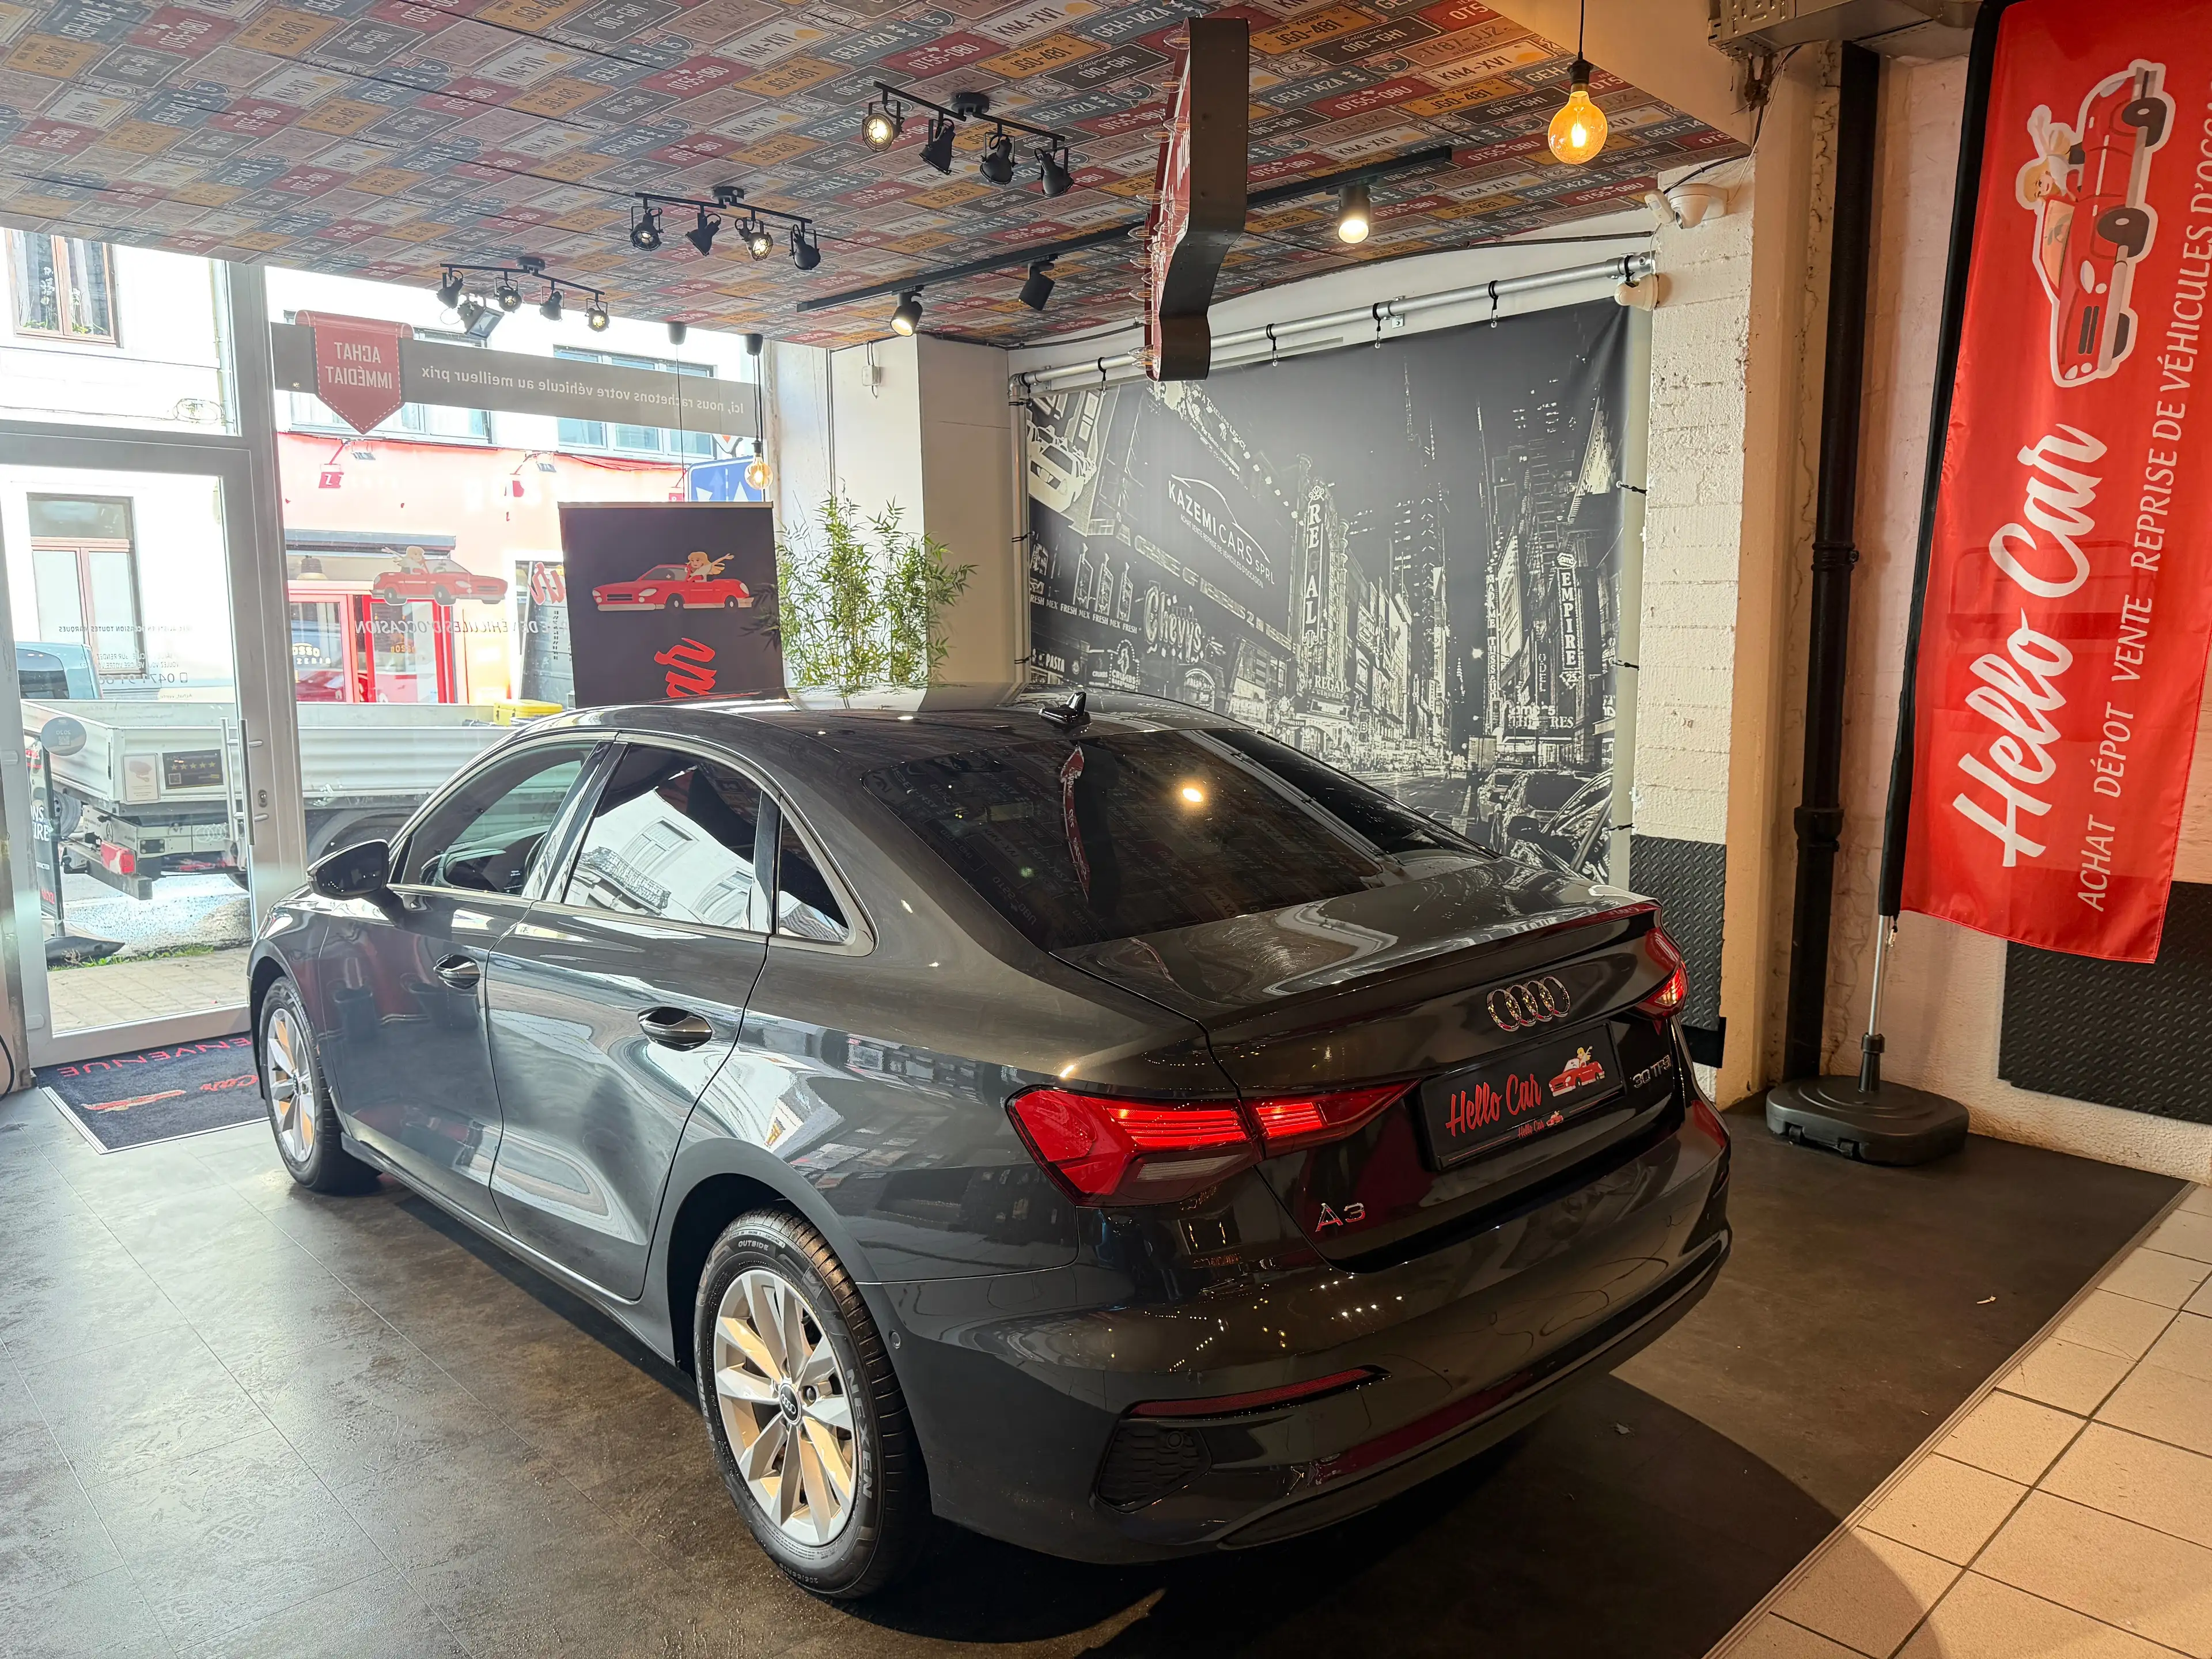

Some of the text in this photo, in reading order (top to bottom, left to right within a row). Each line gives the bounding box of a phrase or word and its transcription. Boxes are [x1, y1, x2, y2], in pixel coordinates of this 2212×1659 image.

[1091, 6, 1176, 38] GEH-142A
[1270, 78, 1349, 104] GEH-142A
[1380, 62, 1398, 71] 15
[2158, 224, 2212, 389] VÉHICULES
[2153, 401, 2186, 441] DE
[1168, 480, 1217, 536] KAZEMI
[1218, 524, 1253, 565] CARS
[1255, 559, 1275, 585] SPRL
[2130, 445, 2178, 573] REPRISE
[1305, 503, 1323, 626] REGAL
[1029, 593, 1138, 634] RESH MEX FRESH MEX FRESH MEX FRESH
[1560, 571, 1577, 666] EMPIRE
[2112, 594, 2153, 683] VENTE
[1046, 653, 1065, 672] PASTA
[1953, 423, 2108, 868] Hello Car
[1314, 674, 1347, 693] REGAL
[2090, 701, 2135, 798] DÉPOT
[2077, 814, 2116, 912] ACHAT
[1633, 1069, 1651, 1088] 30
[1445, 1073, 1543, 1138] Hello Car
[1517, 1120, 1545, 1139] Hello Car
[1315, 1202, 1367, 1233] A3
[738, 1240, 769, 1251] OUTSIDE
[845, 1368, 875, 1501] NEXEN
